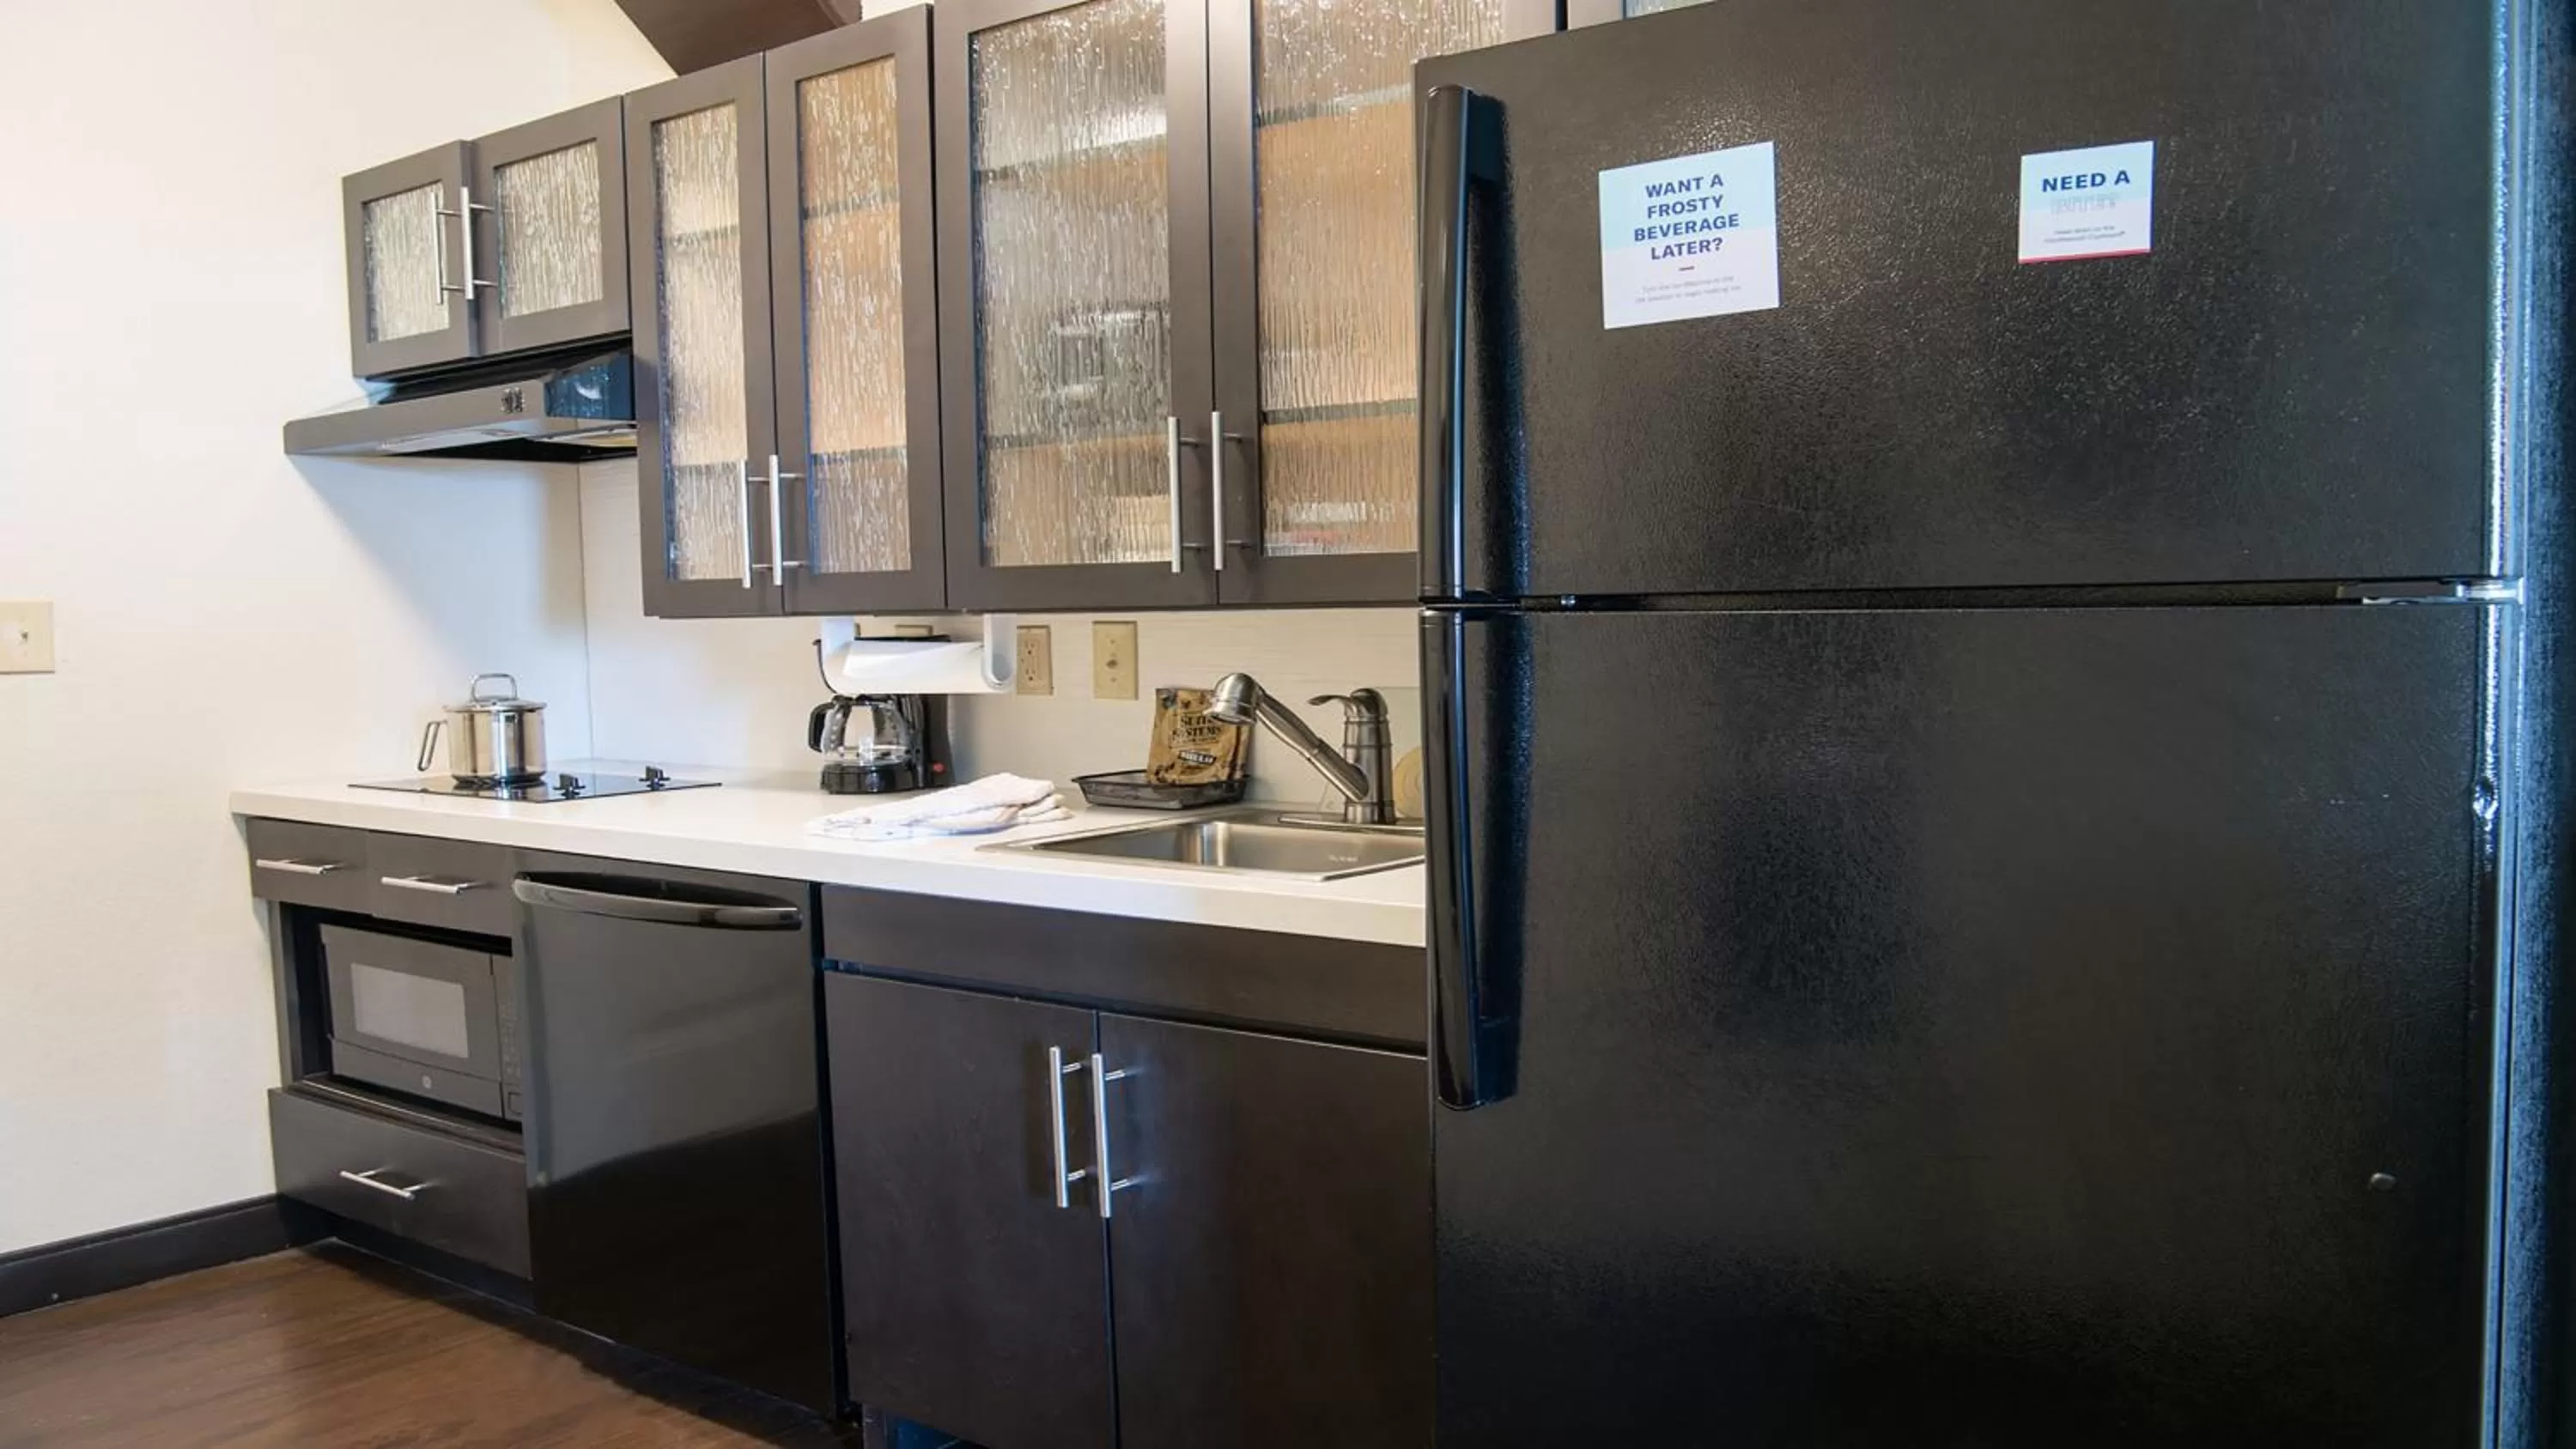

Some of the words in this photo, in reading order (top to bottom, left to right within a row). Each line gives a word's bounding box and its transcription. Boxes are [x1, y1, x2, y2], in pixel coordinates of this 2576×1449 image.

[1645, 176, 1704, 198] WANT
[1710, 173, 1724, 188] A
[2042, 173, 2106, 192] NEED
[2114, 170, 2130, 185] A
[1647, 194, 1724, 219] FROSTY
[1634, 213, 1740, 242] BEVERAGE
[1650, 237, 1723, 260] LATER?
